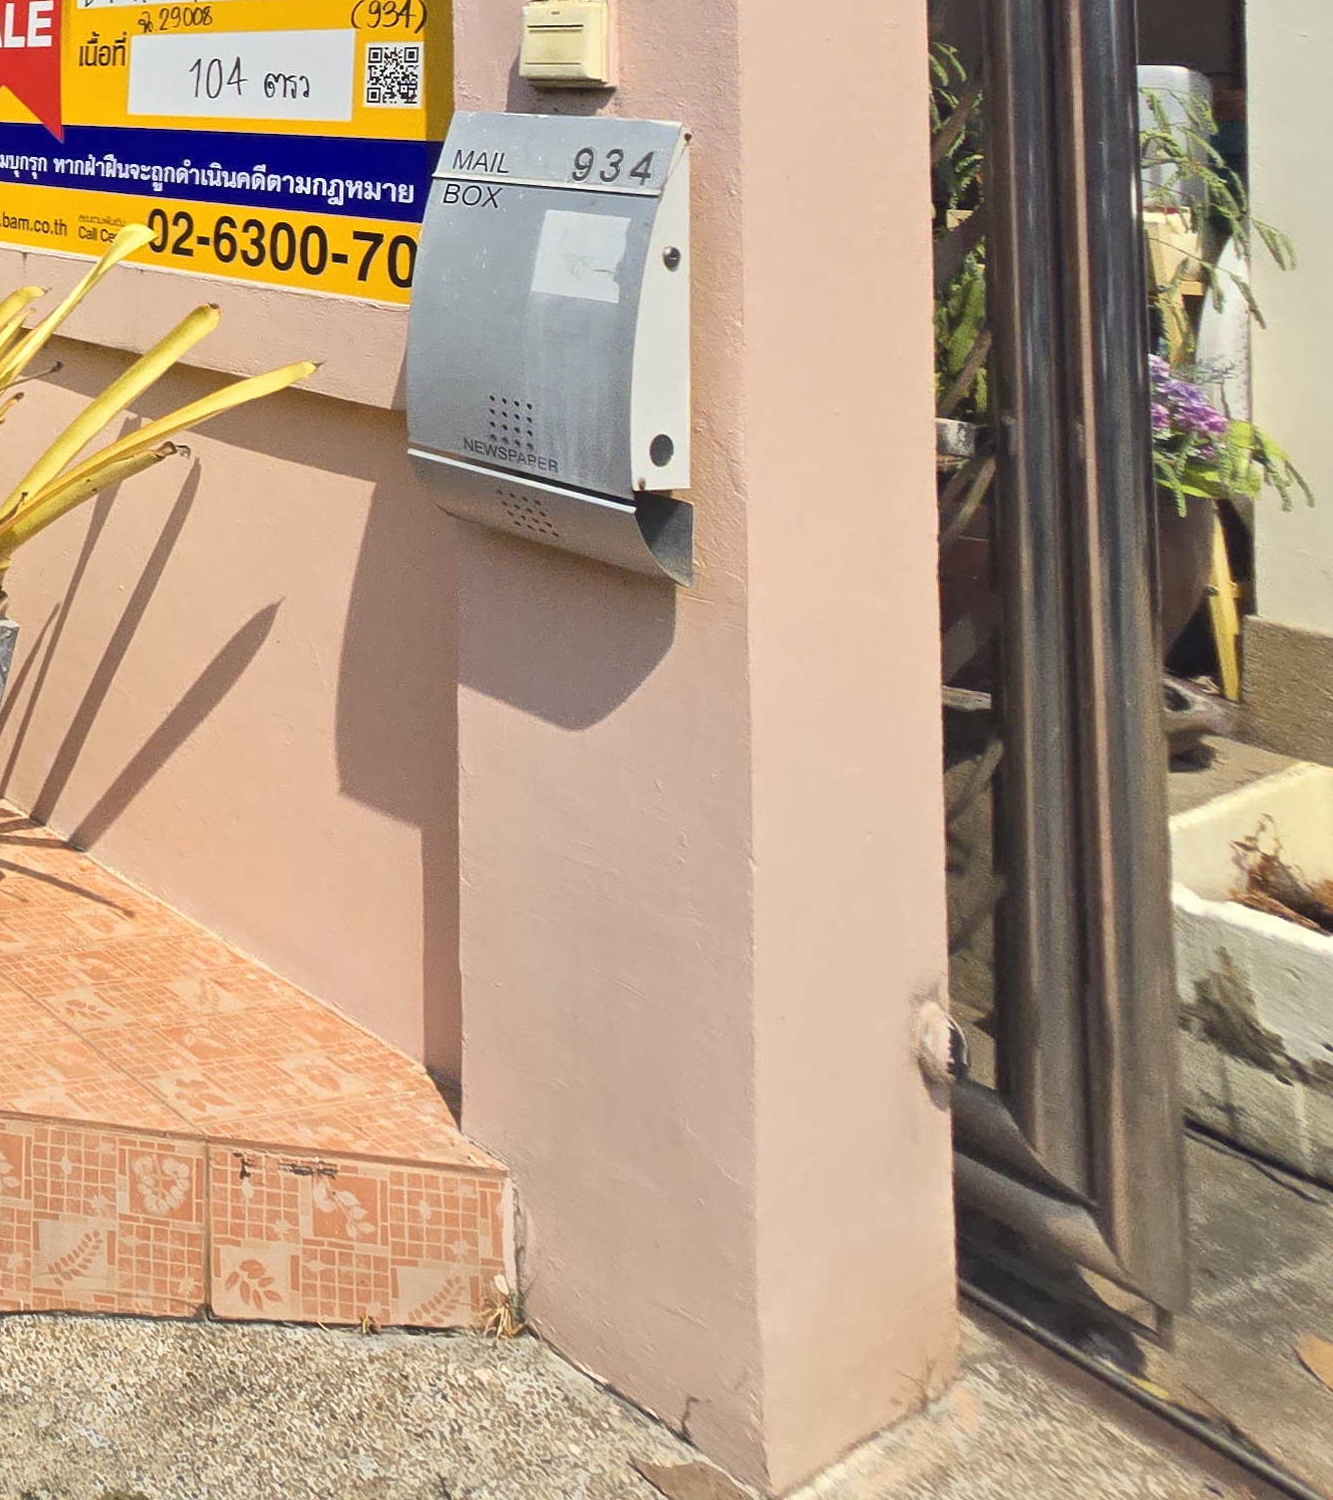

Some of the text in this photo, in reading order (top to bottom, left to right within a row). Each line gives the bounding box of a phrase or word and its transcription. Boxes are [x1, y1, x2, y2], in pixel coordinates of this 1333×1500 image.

[78, 31, 127, 67] เนื้อที่
[188, 56, 249, 99] 104
[452, 149, 510, 174] MAIL
[571, 146, 655, 186] 934
[442, 183, 503, 209] BOX
[78, 226, 98, 241] Call
[463, 437, 560, 474] NEWSPAPER
